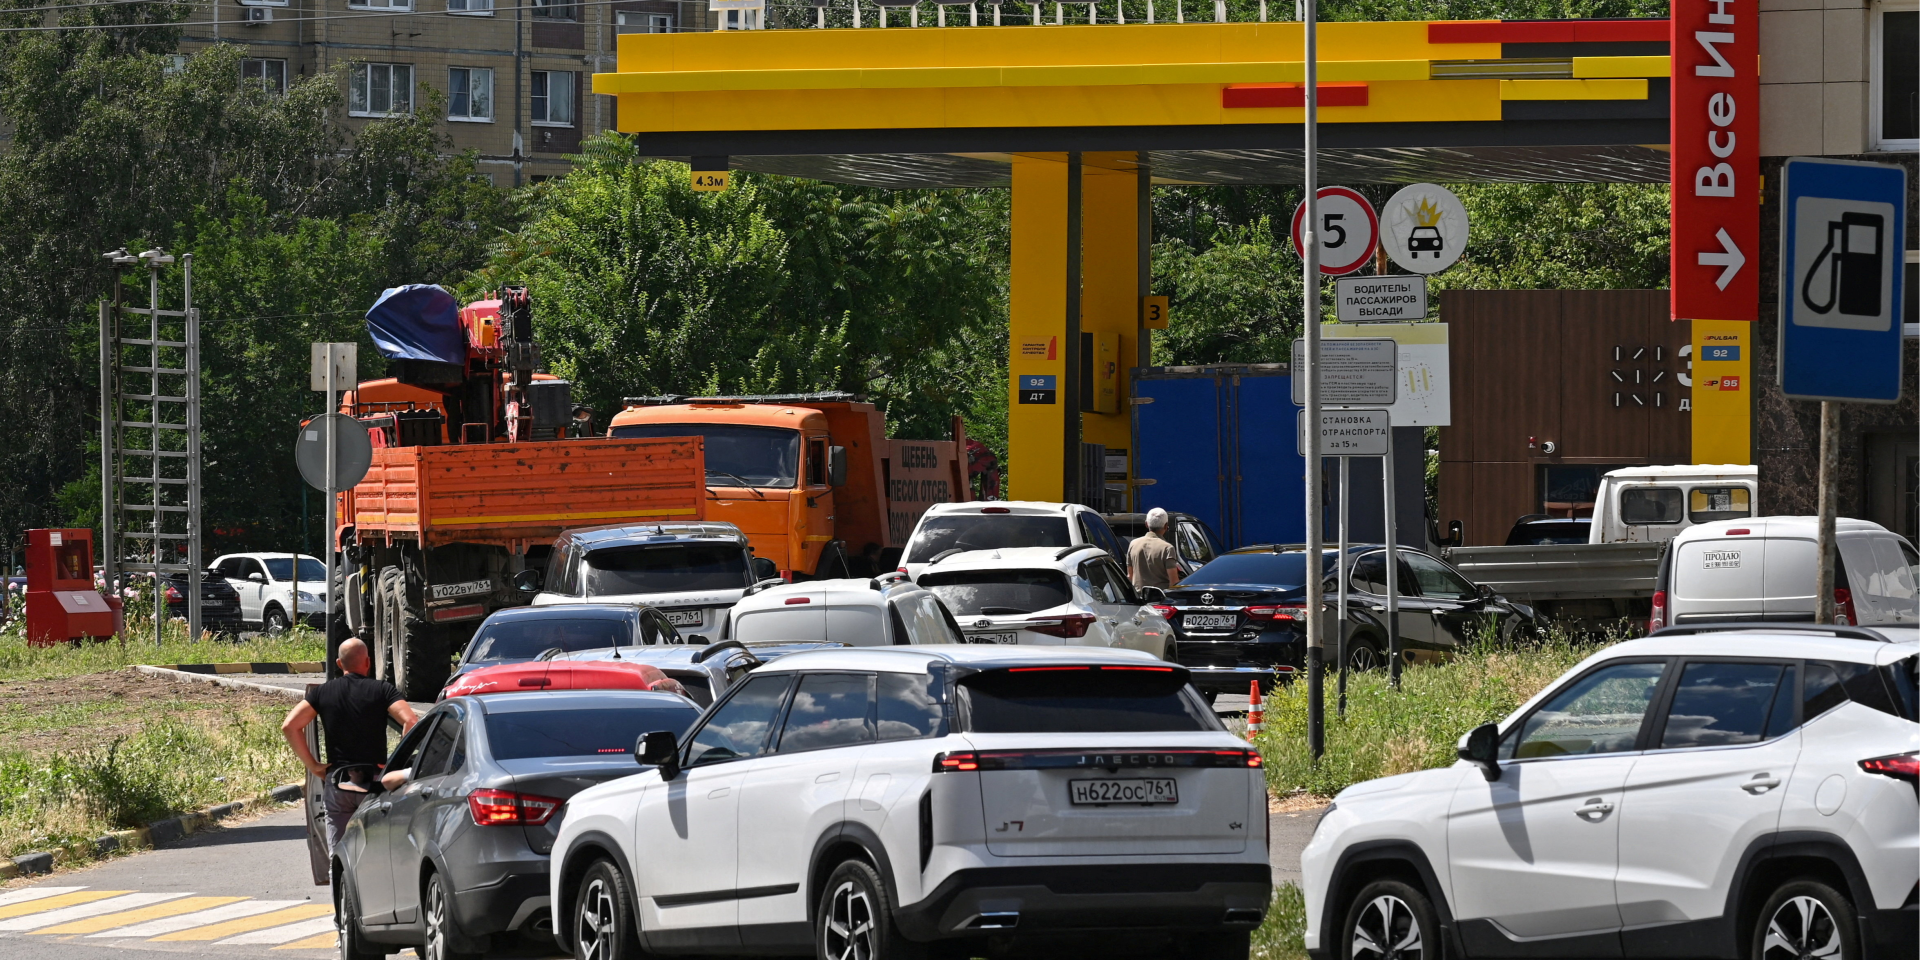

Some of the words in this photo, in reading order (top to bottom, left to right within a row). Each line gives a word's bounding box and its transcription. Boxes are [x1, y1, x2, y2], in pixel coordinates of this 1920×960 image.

[1695, 92, 1736, 197] Все
[1323, 213, 1347, 249] 5
[1354, 284, 1411, 294] ВОДИТЕЛЬ!
[1346, 295, 1417, 306] ПАССАЖИРОВ
[1149, 304, 1160, 320] 3
[1359, 307, 1403, 316] ВЫСАДИ
[1030, 378, 1045, 386] 92
[1029, 393, 1045, 401] ДТ
[902, 445, 938, 472] ЩЕБЕНЬ
[890, 480, 919, 502] ПЕСОК
[920, 480, 948, 503] ОТСЕВ
[1705, 552, 1739, 561] ПРОДАЮ
[683, 611, 699, 620] 761
[1185, 615, 1220, 626] В022ОВ
[1221, 615, 1235, 623] 761
[998, 634, 1014, 643] 761
[1077, 782, 1145, 802] Н622ОС
[1146, 781, 1173, 795] 761
[995, 820, 1024, 832] J7
